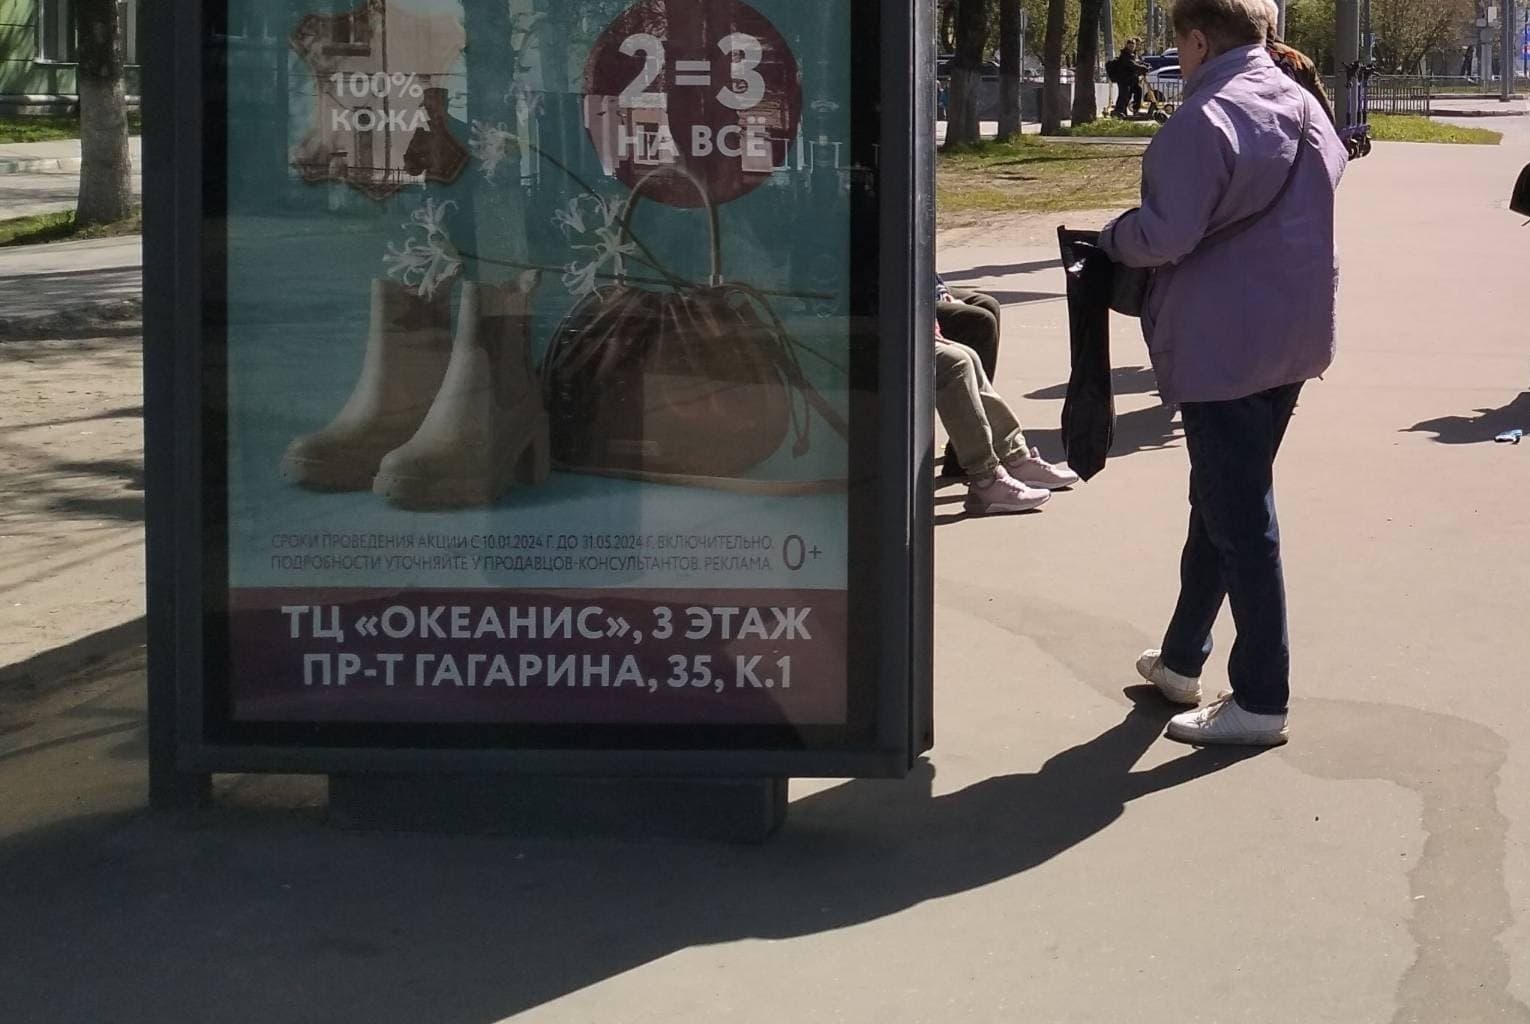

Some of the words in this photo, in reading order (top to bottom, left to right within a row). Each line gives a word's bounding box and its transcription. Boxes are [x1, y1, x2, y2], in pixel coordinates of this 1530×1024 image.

[329, 72, 423, 99] 100%
[617, 33, 766, 109] 2=3
[331, 108, 431, 132] КОЖА
[618, 124, 679, 157] НА
[691, 116, 767, 157] ВСЁ
[322, 535, 415, 549] ПРОВЕДЕНИЯ
[557, 535, 577, 550] ДО
[271, 555, 382, 570] ПОДРОБНОСТИ
[386, 553, 468, 570] УТОЧНЯЙТЕ
[281, 605, 344, 643] ТЦ
[354, 605, 643, 644] «ОКЕАНИС»,
[652, 606, 673, 640] 3
[685, 606, 812, 640] ЭТАЖ
[303, 653, 404, 686] ПР-Т
[415, 653, 658, 693] ГАГАРИНА,
[667, 654, 725, 693] 35,
[735, 655, 791, 688] К.1
